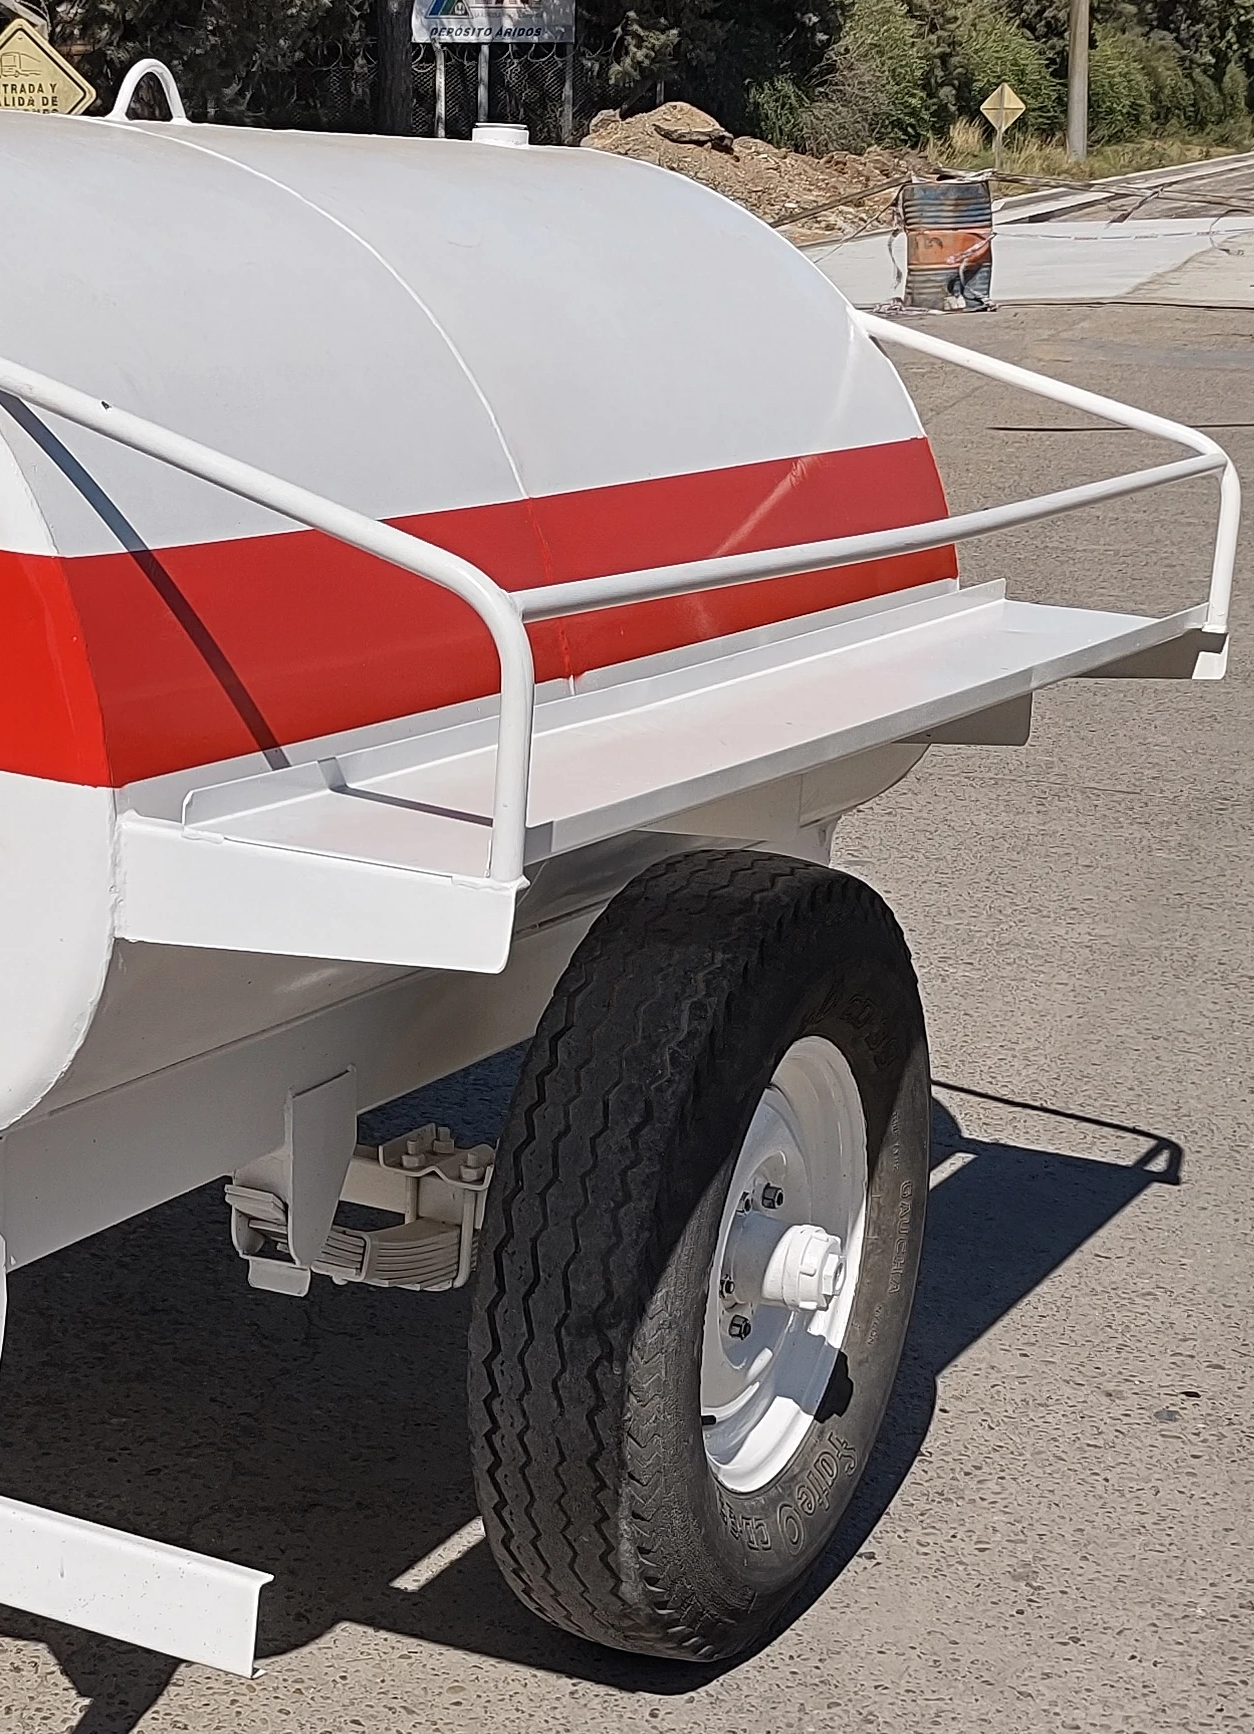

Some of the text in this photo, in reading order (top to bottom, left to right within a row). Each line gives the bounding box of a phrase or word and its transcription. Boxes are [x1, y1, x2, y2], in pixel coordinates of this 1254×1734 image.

[49, 83, 57, 93] Y
[41, 96, 58, 107] DE
[888, 1179, 914, 1295] GAUCHA
